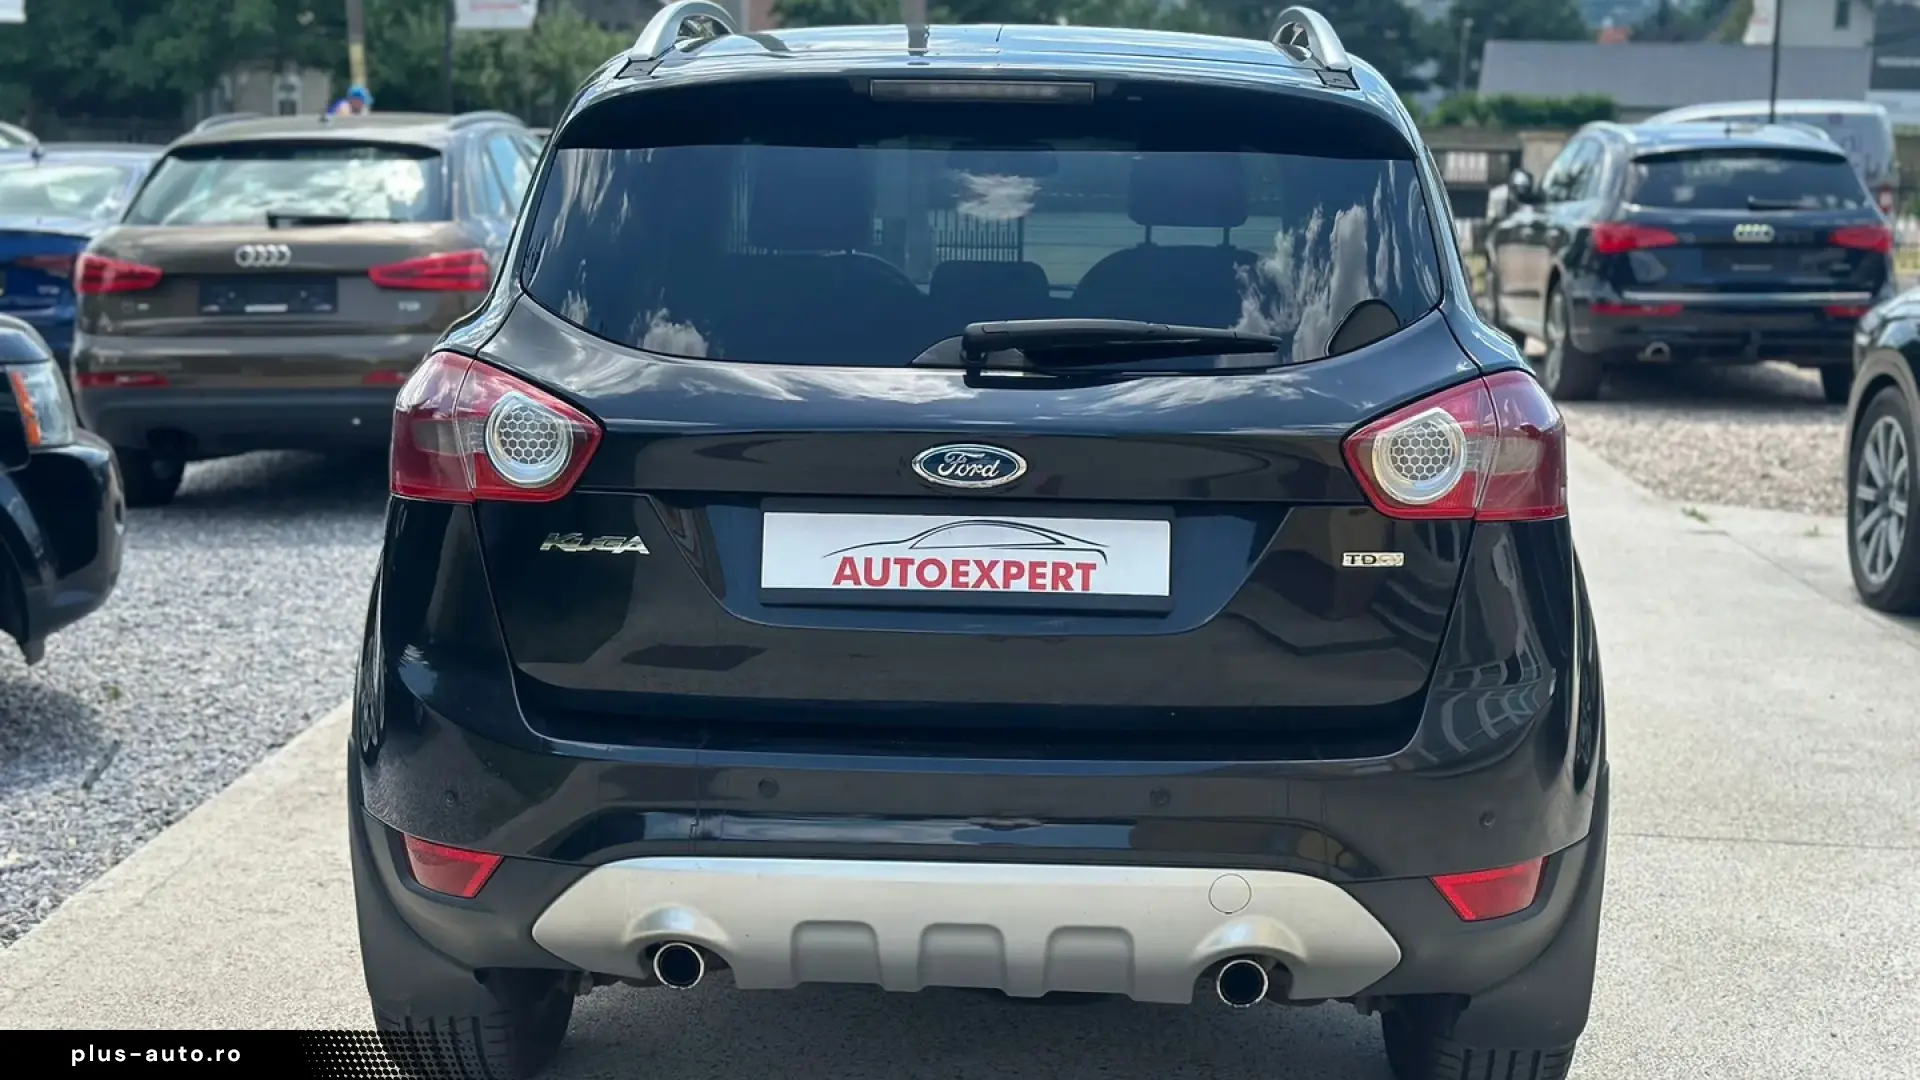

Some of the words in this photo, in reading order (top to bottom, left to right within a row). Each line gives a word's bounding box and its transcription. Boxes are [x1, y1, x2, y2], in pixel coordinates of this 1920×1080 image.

[937, 451, 1001, 477] Ford
[540, 532, 650, 555] KUGA
[832, 556, 1097, 592] AUTOEXPERT
